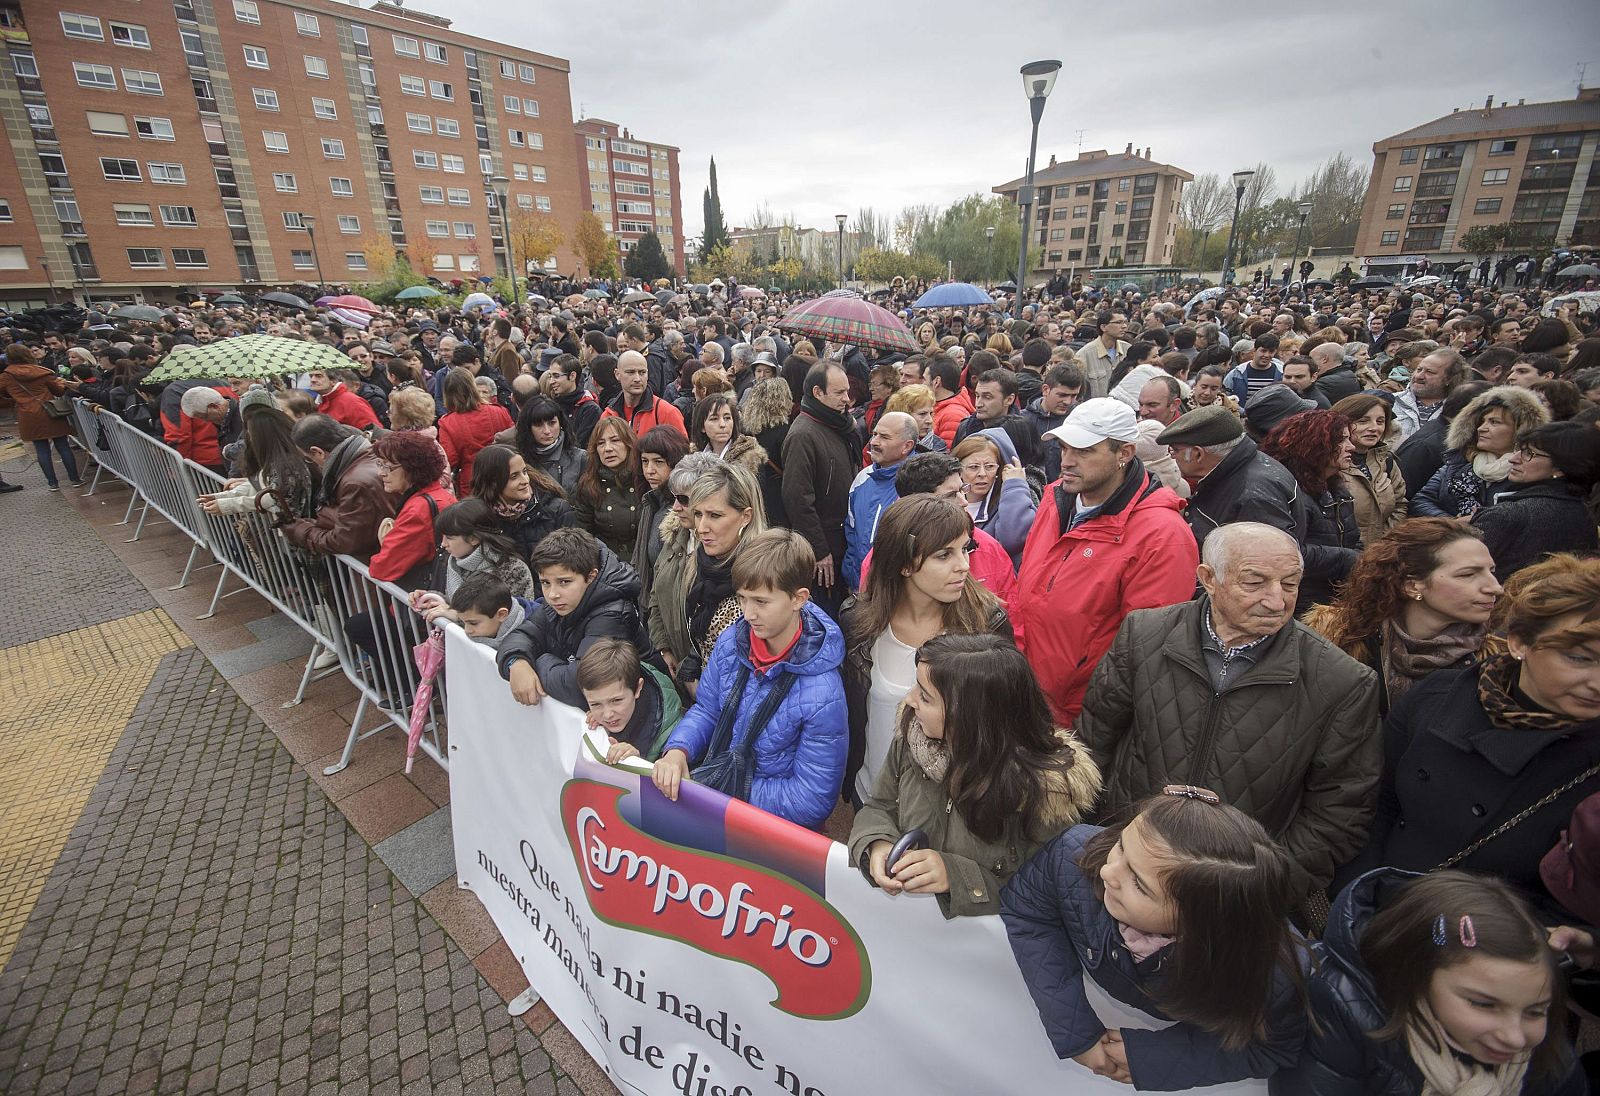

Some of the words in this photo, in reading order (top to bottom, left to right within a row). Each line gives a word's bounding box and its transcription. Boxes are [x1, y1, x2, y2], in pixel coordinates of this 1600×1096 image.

[477, 850, 541, 932] nuestra
[542, 923, 612, 1043] manera
[619, 1026, 664, 1070] de
[519, 839, 561, 901] Que
[564, 896, 605, 978] nada
[612, 966, 647, 1004] ni
[656, 991, 764, 1071] nadie
[576, 806, 832, 966] Campofrío
